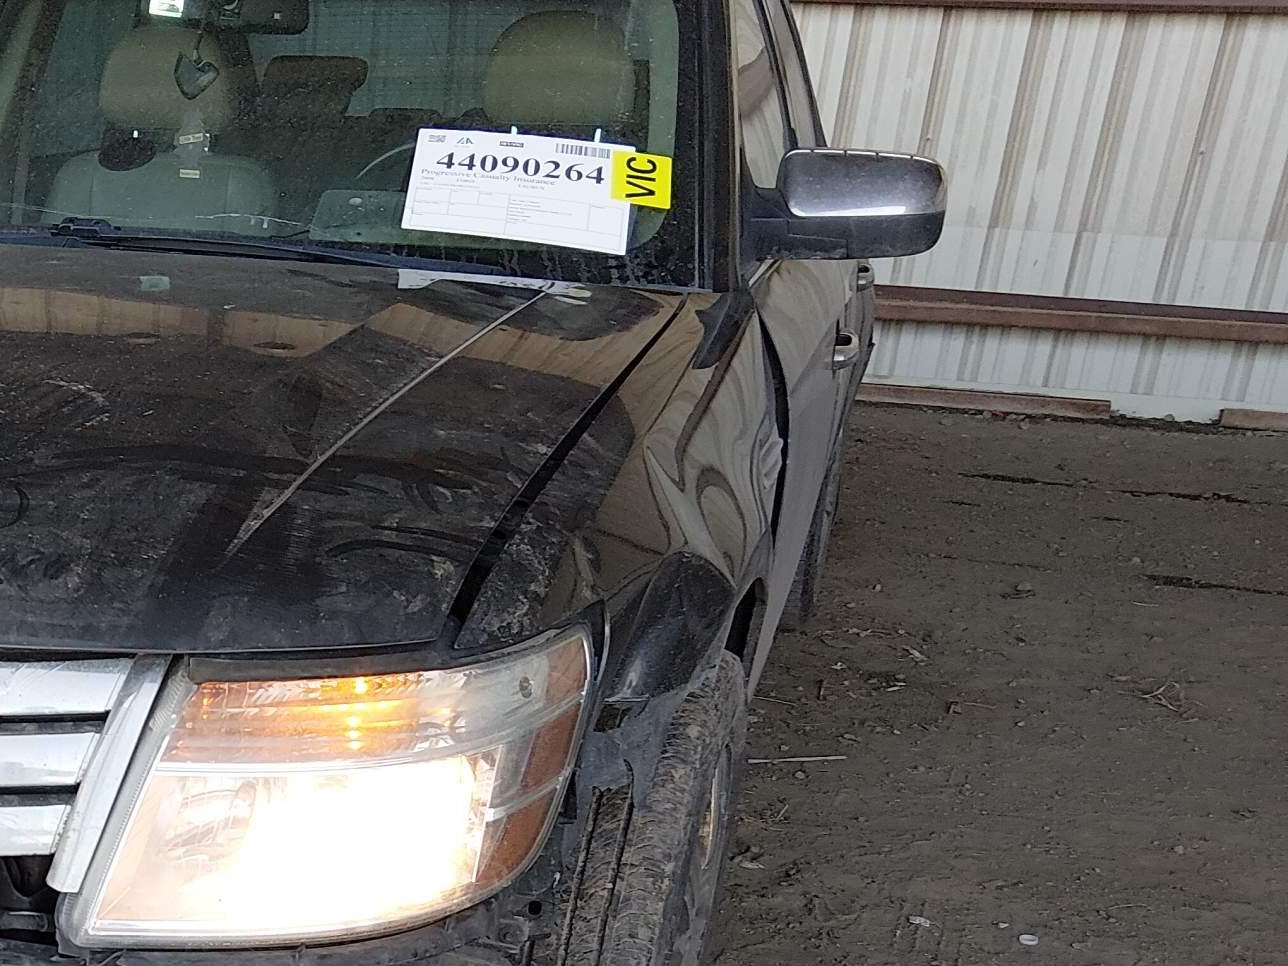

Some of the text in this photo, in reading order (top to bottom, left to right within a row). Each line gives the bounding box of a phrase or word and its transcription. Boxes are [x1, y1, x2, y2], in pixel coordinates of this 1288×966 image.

[421, 168, 472, 178] Progressive
[513, 175, 556, 186] Insurance
[435, 151, 605, 185] 44090264
[625, 156, 658, 198] VIC
